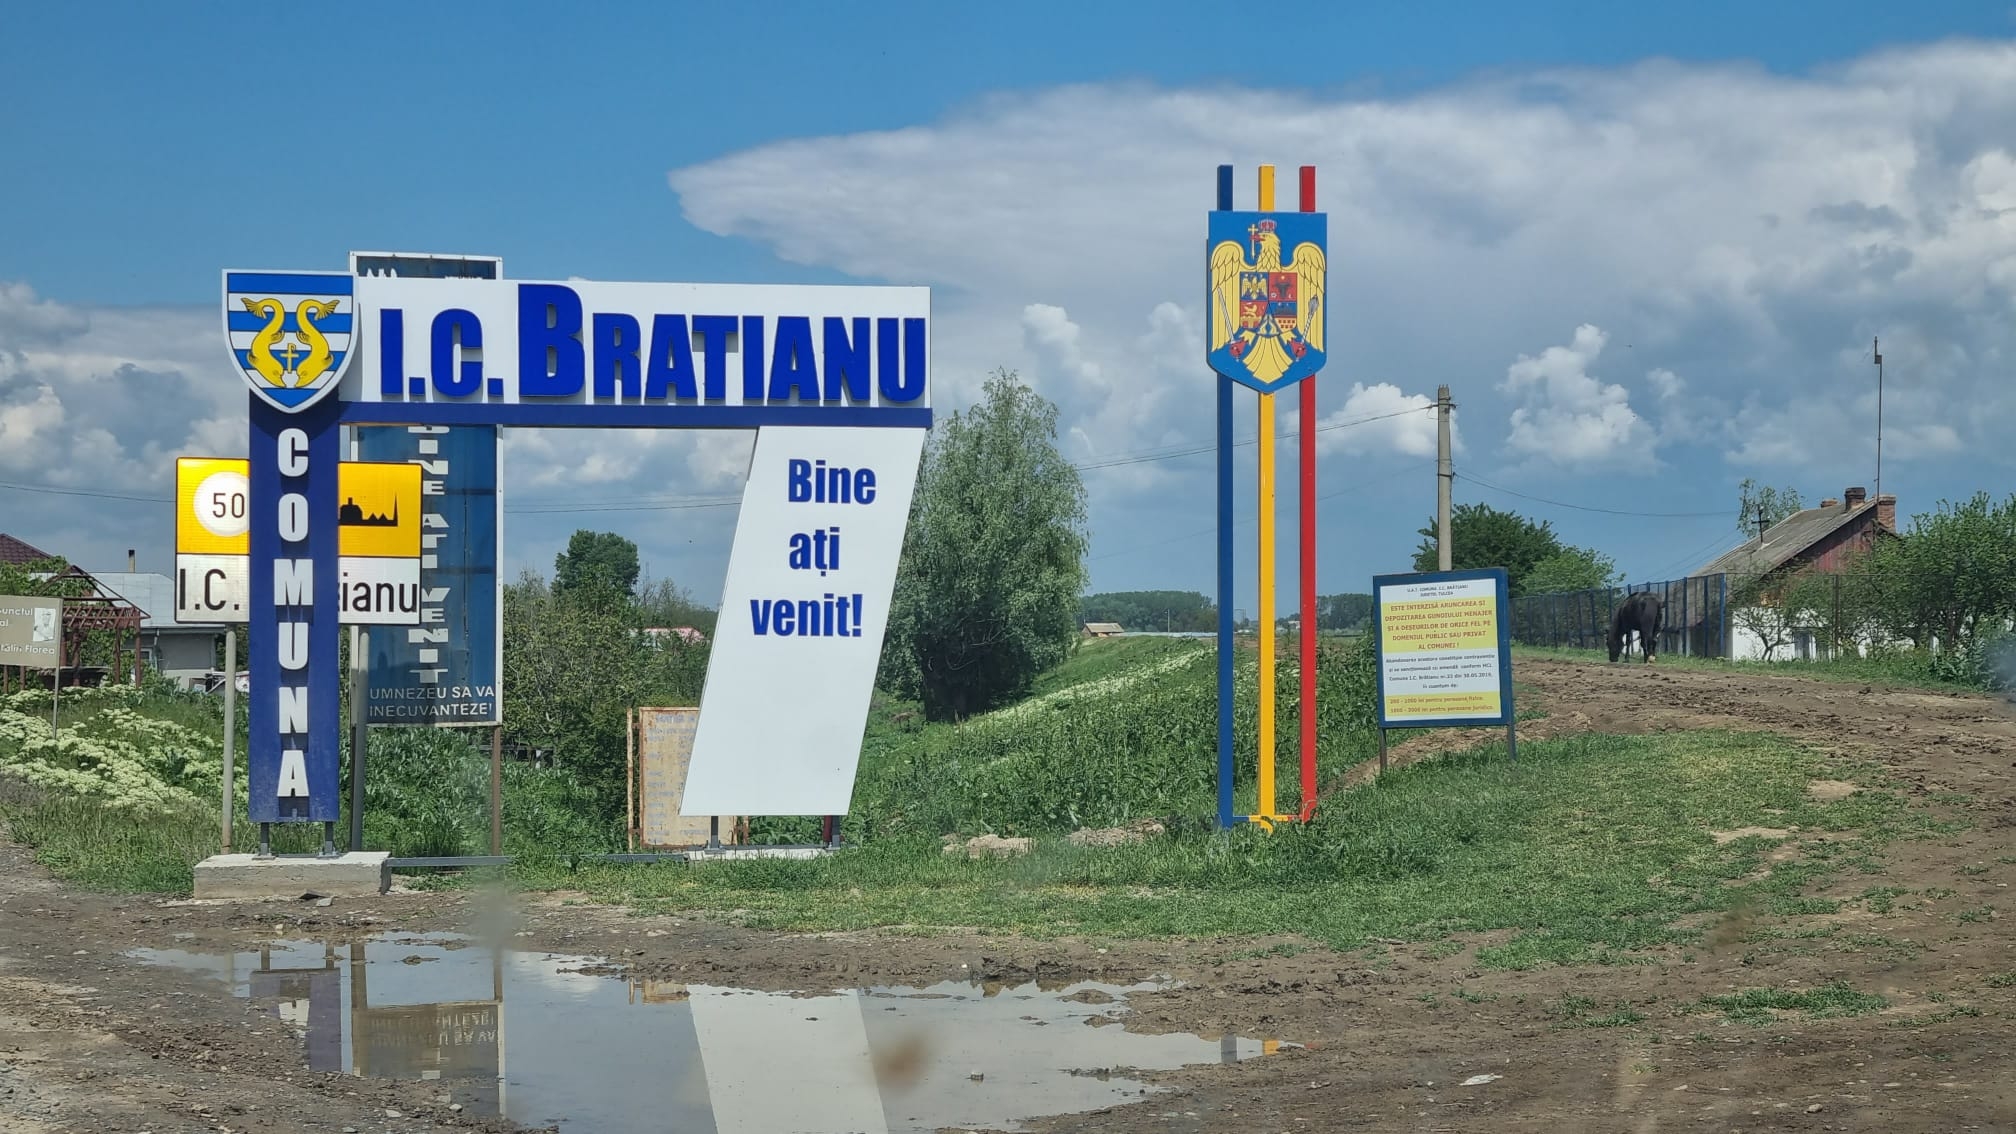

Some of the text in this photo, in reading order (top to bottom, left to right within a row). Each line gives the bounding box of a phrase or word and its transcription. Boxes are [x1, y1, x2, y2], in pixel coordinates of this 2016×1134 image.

[380, 283, 926, 401] I.C. BRATIANU
[788, 459, 877, 505] Bine
[212, 492, 245, 518] 50
[789, 526, 840, 577] ați
[0, 608, 33, 616] unctul
[179, 568, 417, 613] I.C. ianu
[273, 428, 314, 797] COMUNA
[750, 593, 863, 637] venit!
[25, 644, 55, 655] Florea
[370, 686, 495, 700] UMNEZEU SA VA
